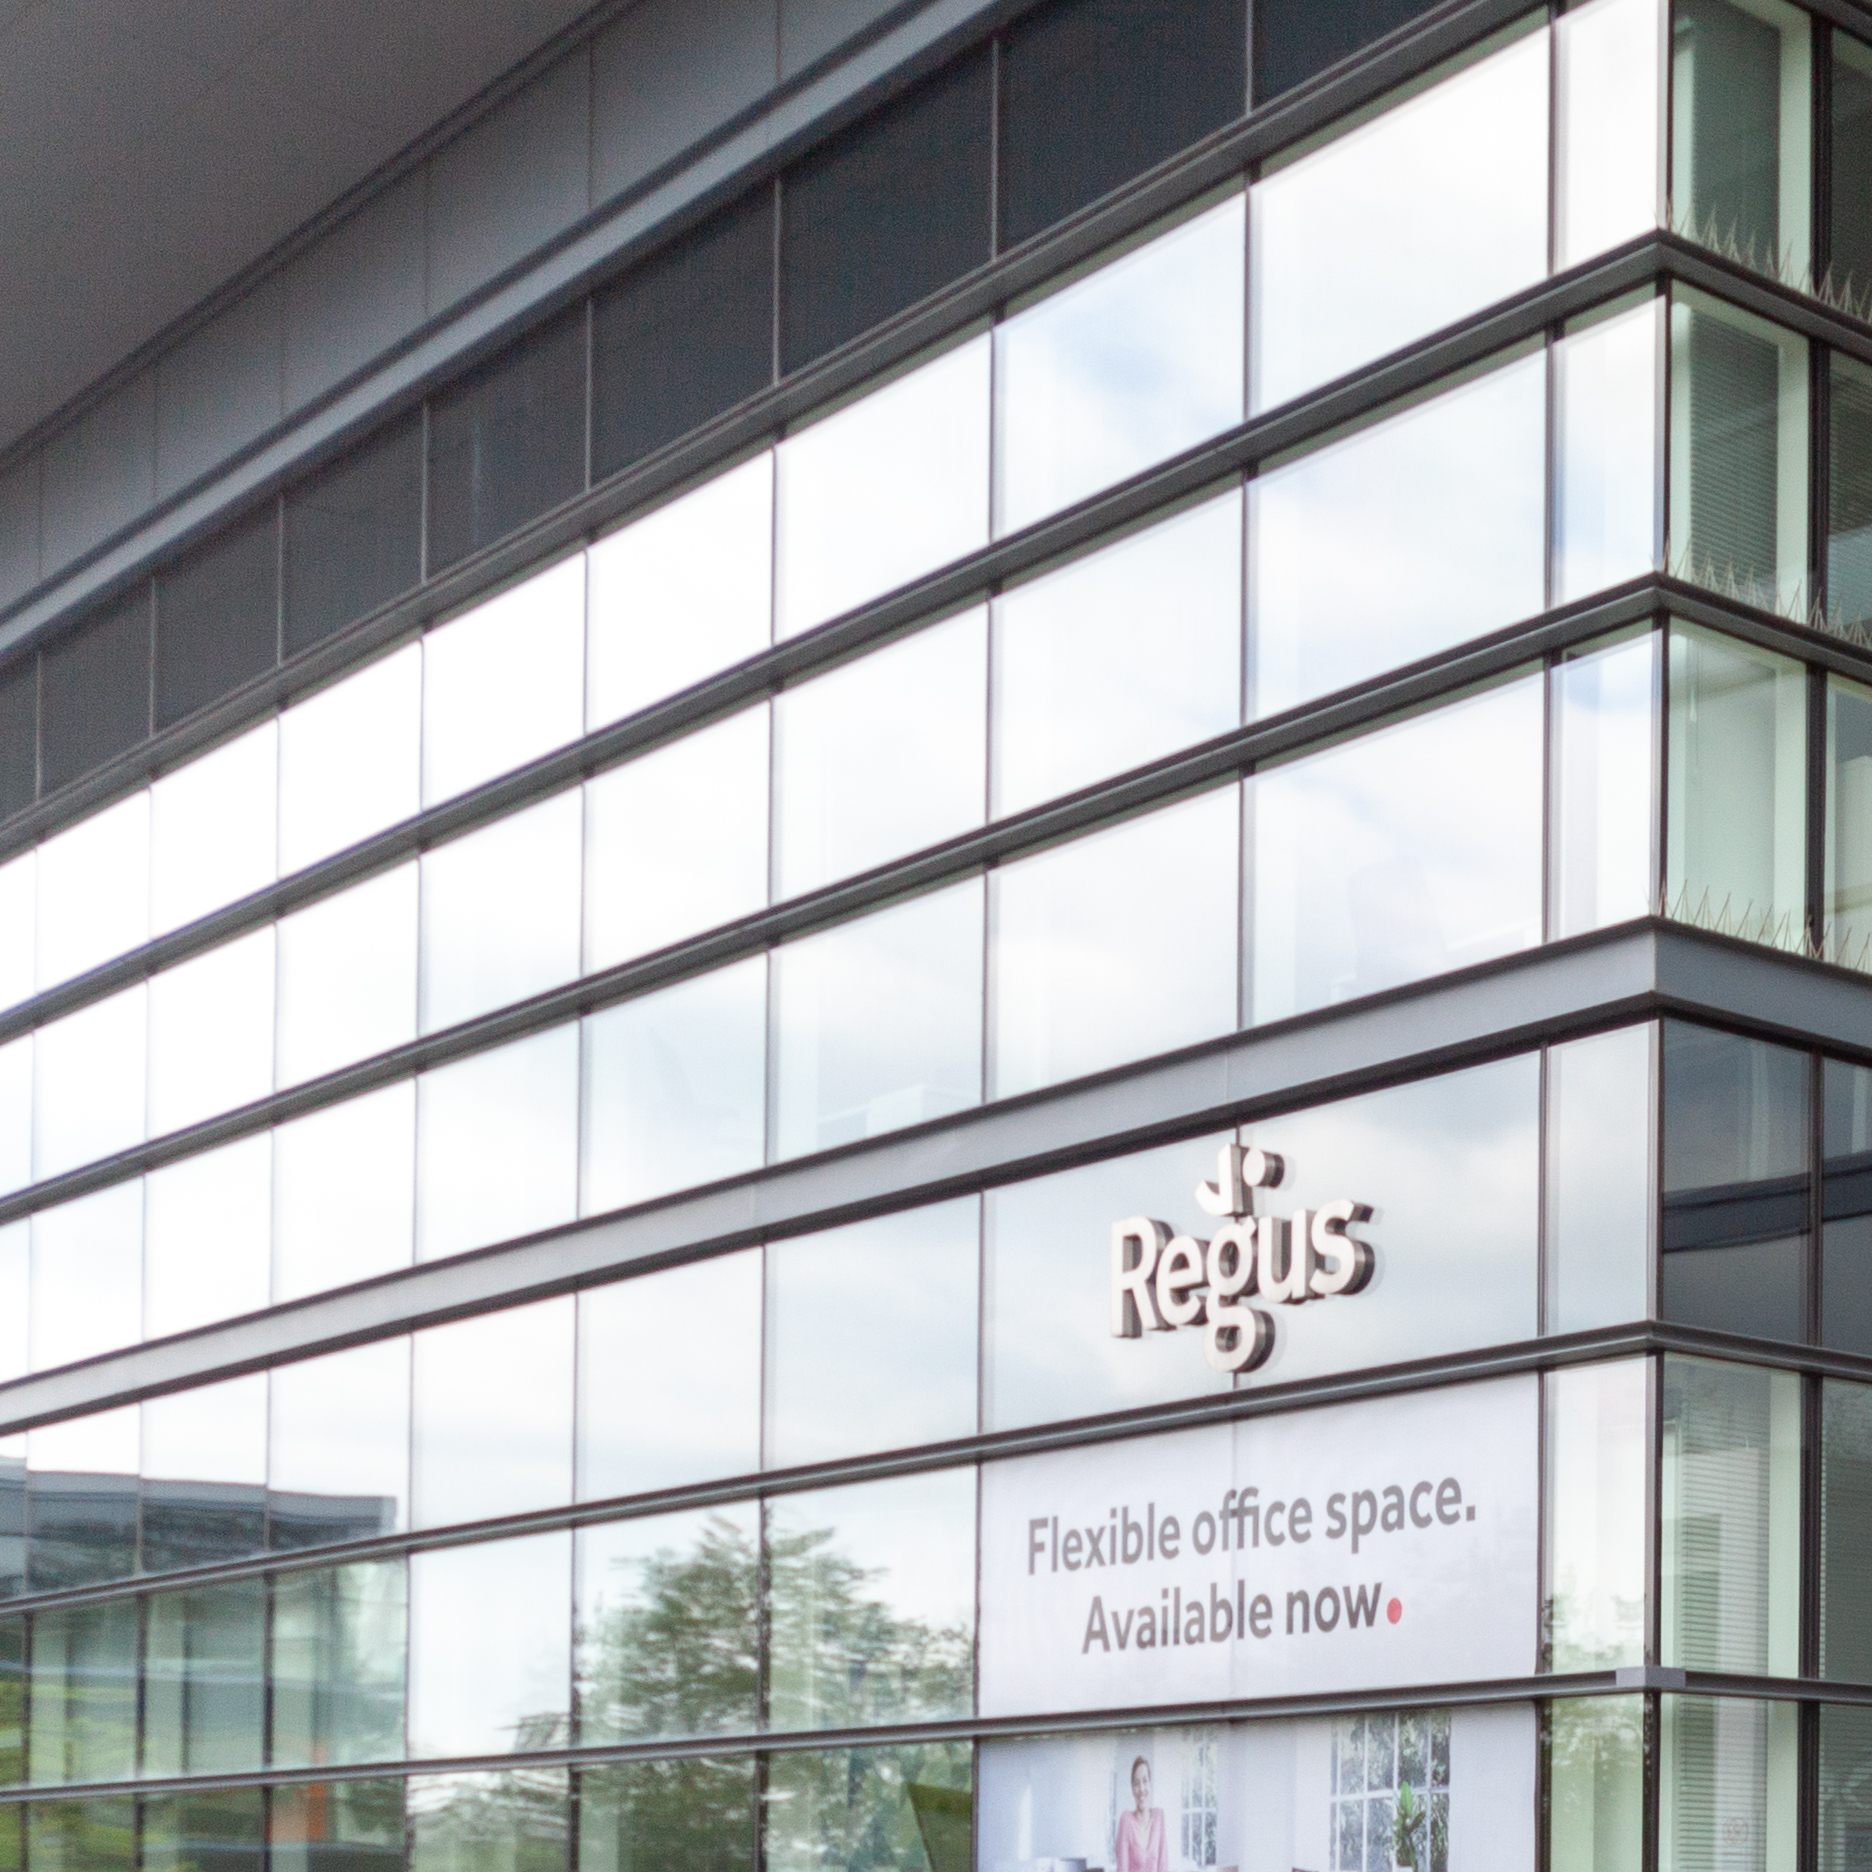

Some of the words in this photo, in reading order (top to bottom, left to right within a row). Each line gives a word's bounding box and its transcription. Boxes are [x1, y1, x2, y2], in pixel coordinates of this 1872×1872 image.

[1110, 1198, 1376, 1374] Regus
[1027, 1501, 1181, 1575] Flexible
[1191, 1486, 1312, 1555] office
[1325, 1476, 1477, 1553] space.
[1081, 1578, 1273, 1655] Available
[1285, 1582, 1403, 1634] now.
